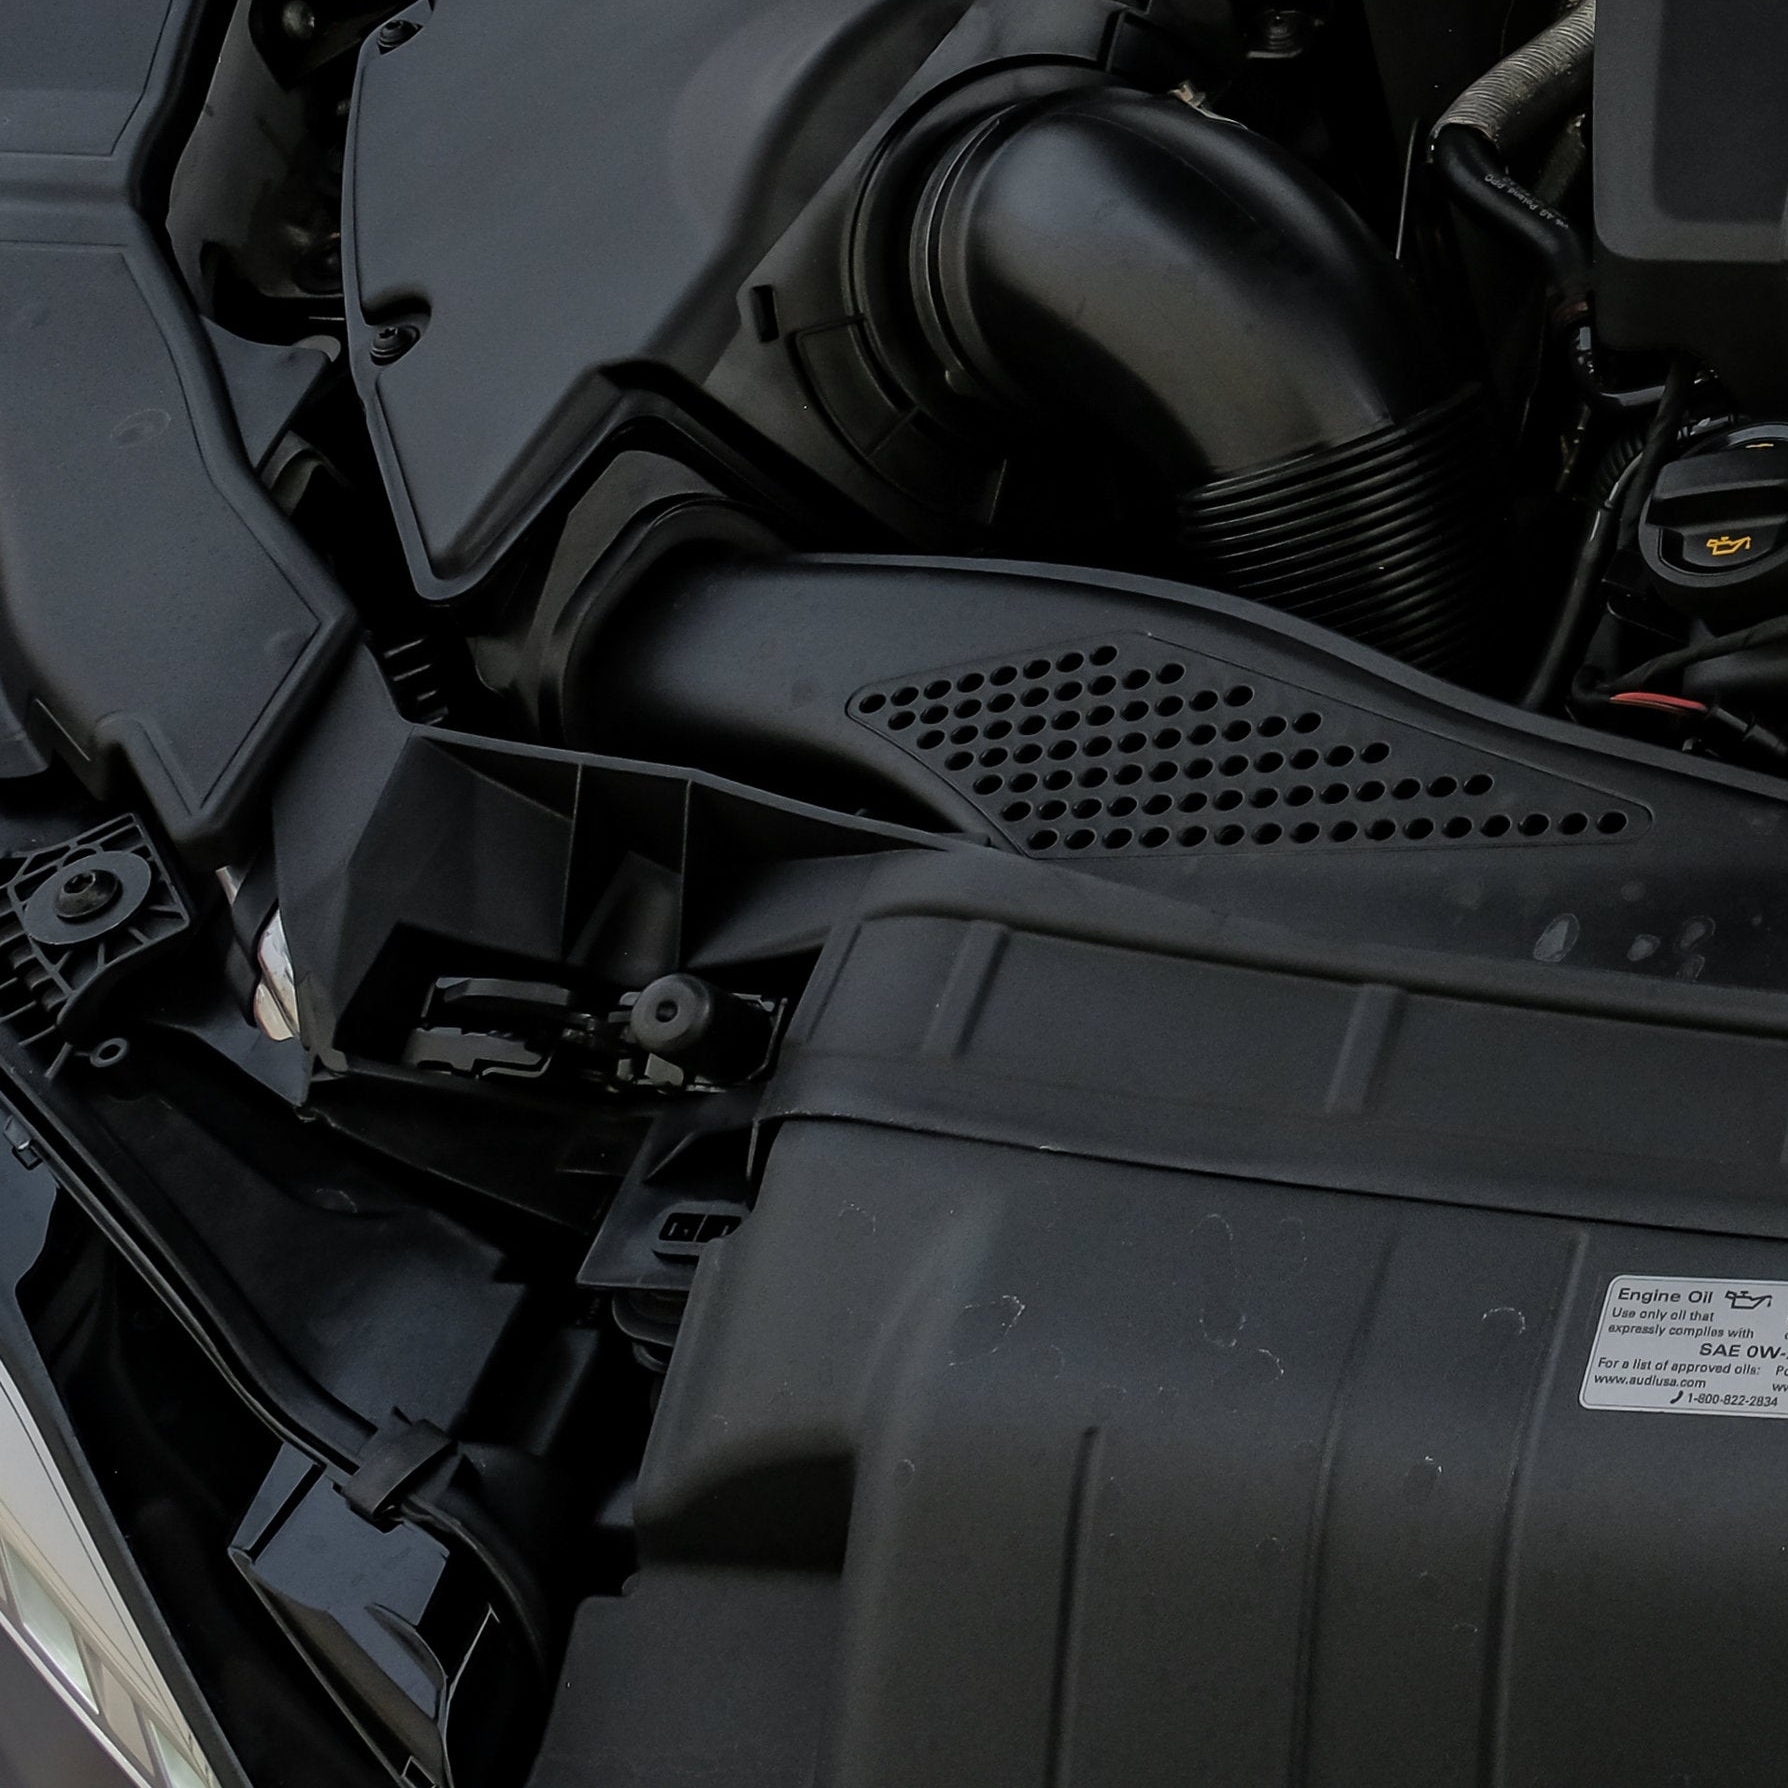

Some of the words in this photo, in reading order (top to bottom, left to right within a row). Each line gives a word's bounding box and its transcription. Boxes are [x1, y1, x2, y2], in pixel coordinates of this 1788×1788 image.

[1618, 1287, 1680, 1304] Engine
[1688, 1290, 1713, 1304] Oil
[1612, 1307, 1635, 1318] Use
[1640, 1309, 1667, 1321] only
[1690, 1310, 1714, 1322] that
[1608, 1324, 1666, 1336] expressly
[1669, 1326, 1724, 1338] complies
[1728, 1328, 1754, 1339] with
[1699, 1343, 1741, 1358] SAE
[1598, 1357, 1619, 1369] For
[1621, 1359, 1629, 1369] a
[1632, 1358, 1651, 1370] list
[1655, 1359, 1669, 1371] of
[1671, 1361, 1731, 1375] approved
[1594, 1374, 1706, 1389] www.audiusa.com
[1688, 1392, 1778, 1407] 1-800-822-2834
